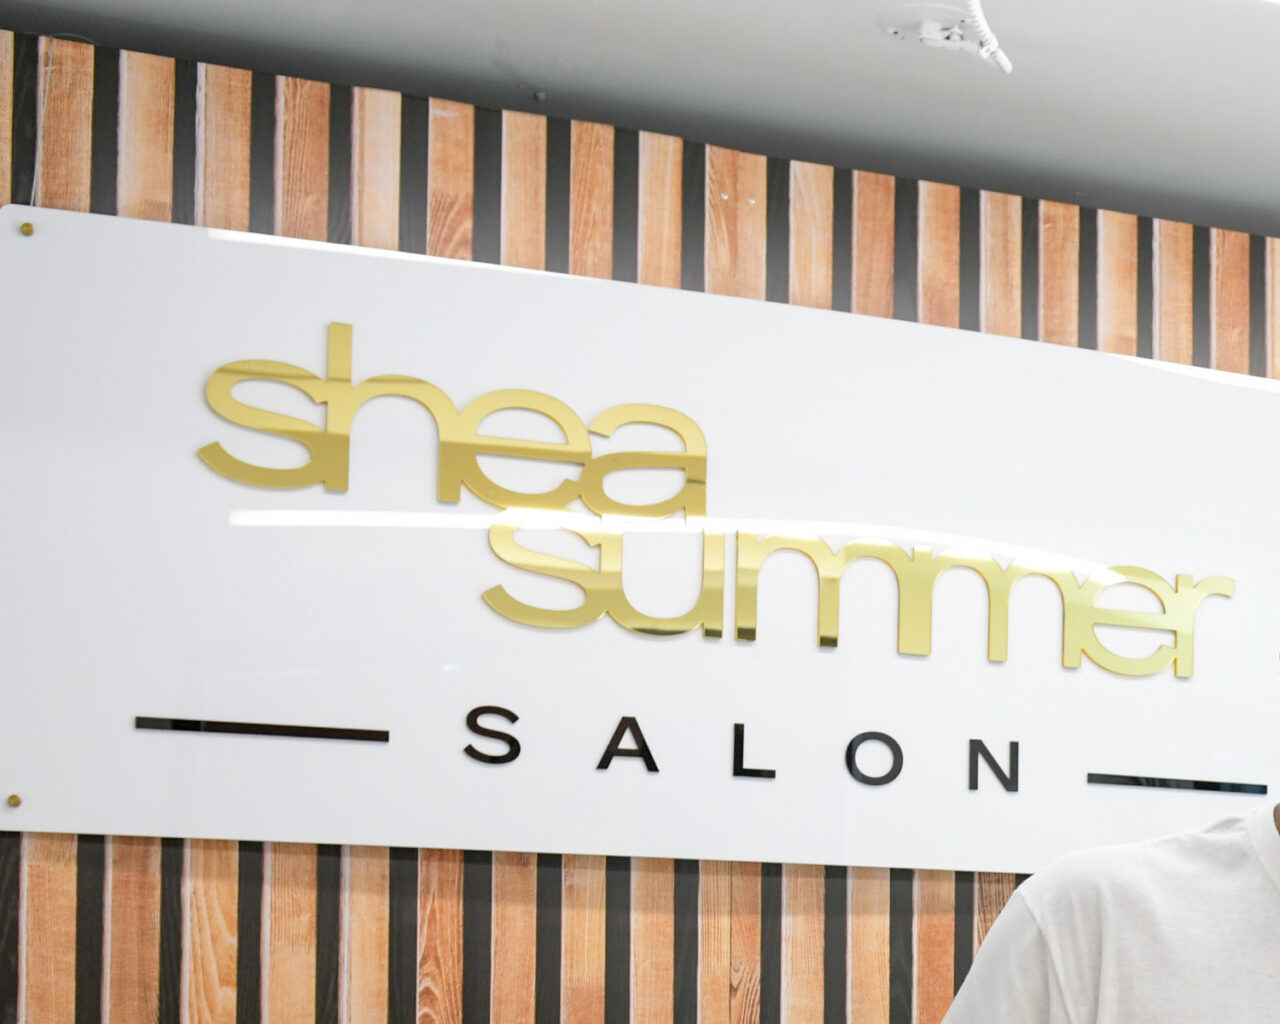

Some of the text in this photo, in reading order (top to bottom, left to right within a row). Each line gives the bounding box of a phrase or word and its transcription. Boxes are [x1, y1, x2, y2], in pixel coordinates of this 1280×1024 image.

[196, 321, 708, 517] shea
[481, 510, 1236, 680] summer
[463, 703, 1021, 795] SALON
